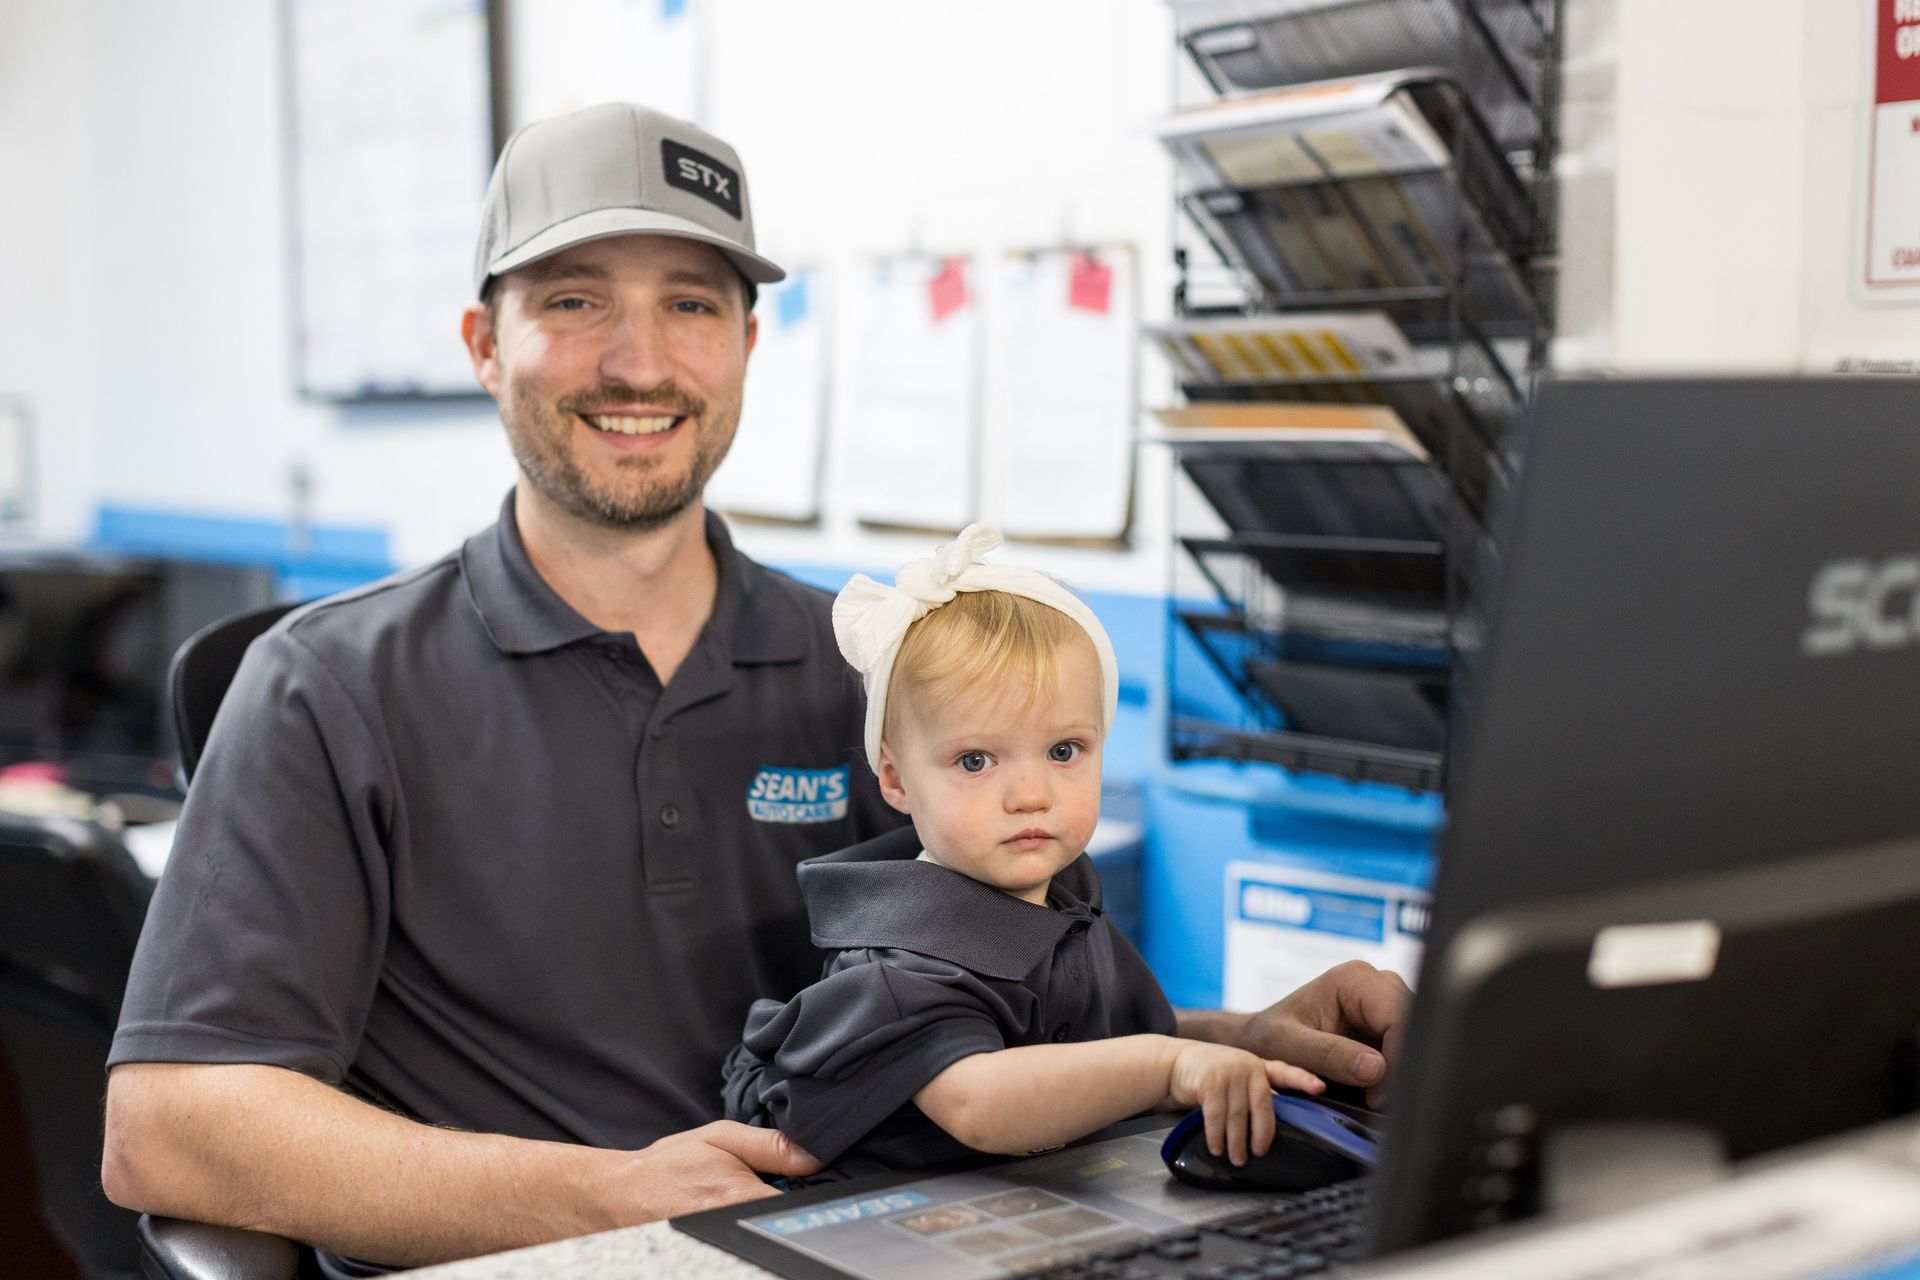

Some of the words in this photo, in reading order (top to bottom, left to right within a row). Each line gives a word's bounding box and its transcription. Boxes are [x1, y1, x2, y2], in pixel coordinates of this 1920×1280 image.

[677, 157, 731, 200] STX
[1802, 558, 1920, 656] SC
[750, 771, 844, 801] SEAN'S
